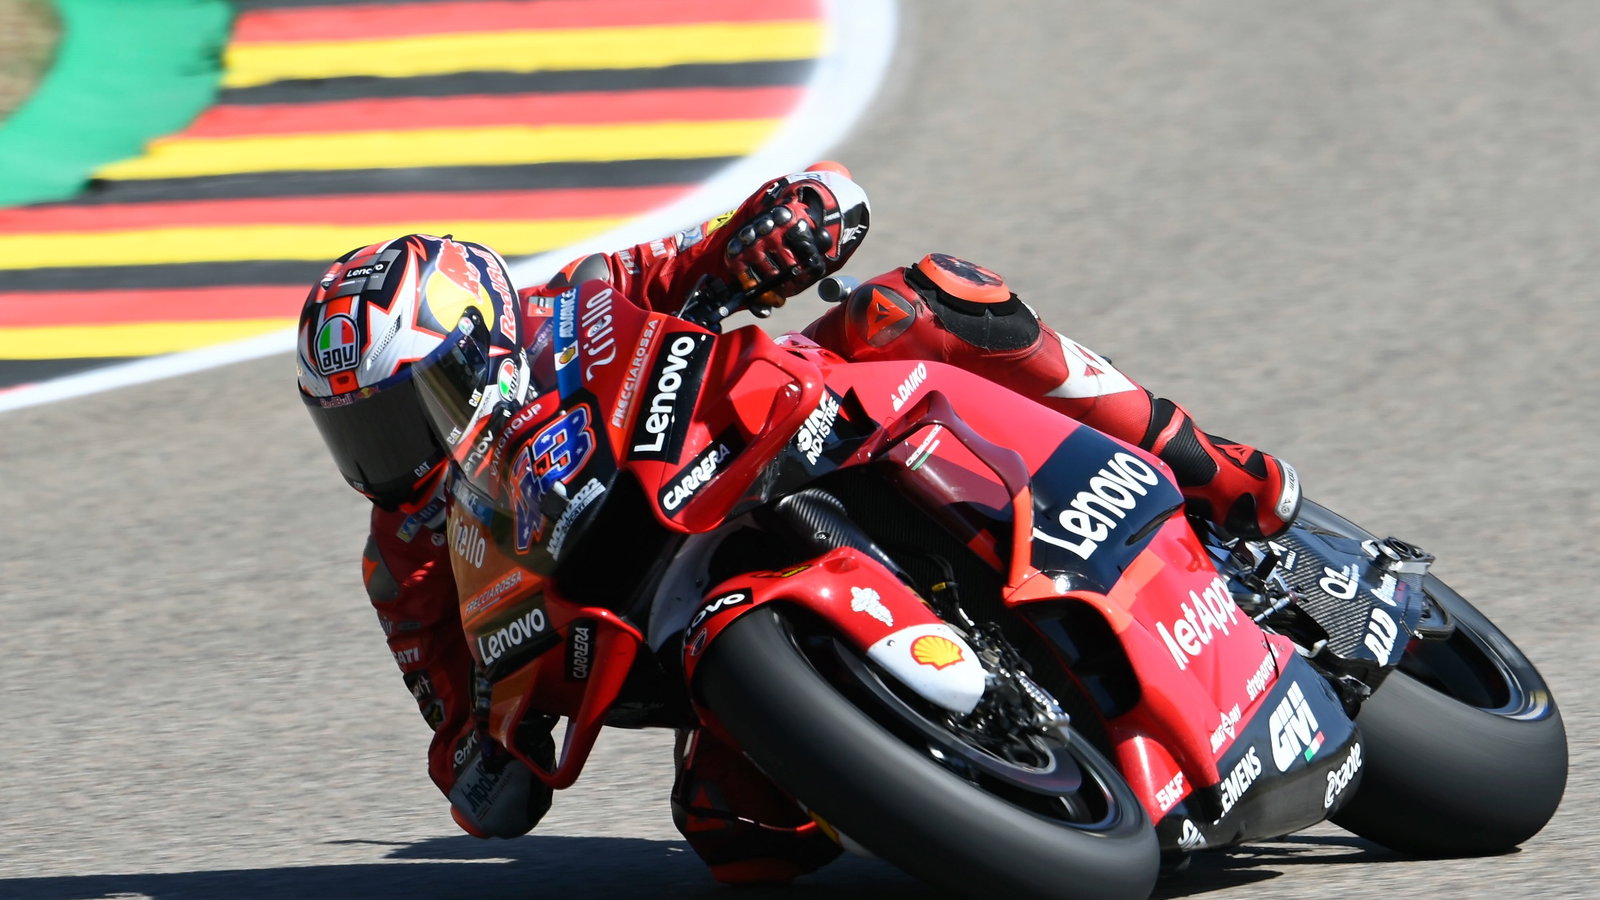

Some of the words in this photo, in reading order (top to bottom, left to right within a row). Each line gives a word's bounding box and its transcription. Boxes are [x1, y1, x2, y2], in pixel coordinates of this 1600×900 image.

[560, 288, 576, 338] ADVANCE
[322, 344, 354, 370] agv
[611, 320, 658, 428] FRECCIAROSSA
[468, 389, 482, 408] CAT
[634, 336, 695, 453] Lenovo
[898, 362, 927, 404] DAIKO
[447, 427, 462, 445] CAT
[463, 429, 494, 474] enov
[414, 461, 432, 478] CAT
[662, 443, 731, 511] CARRERA
[1033, 452, 1159, 560] Lenovo
[464, 571, 523, 616] FRECCIAROSSA
[478, 608, 545, 666] Lenovo
[572, 626, 589, 679] CARRERA
[1269, 680, 1319, 773] GIVI
[1155, 771, 1185, 812] SKF
[1219, 745, 1262, 820] EMENS
